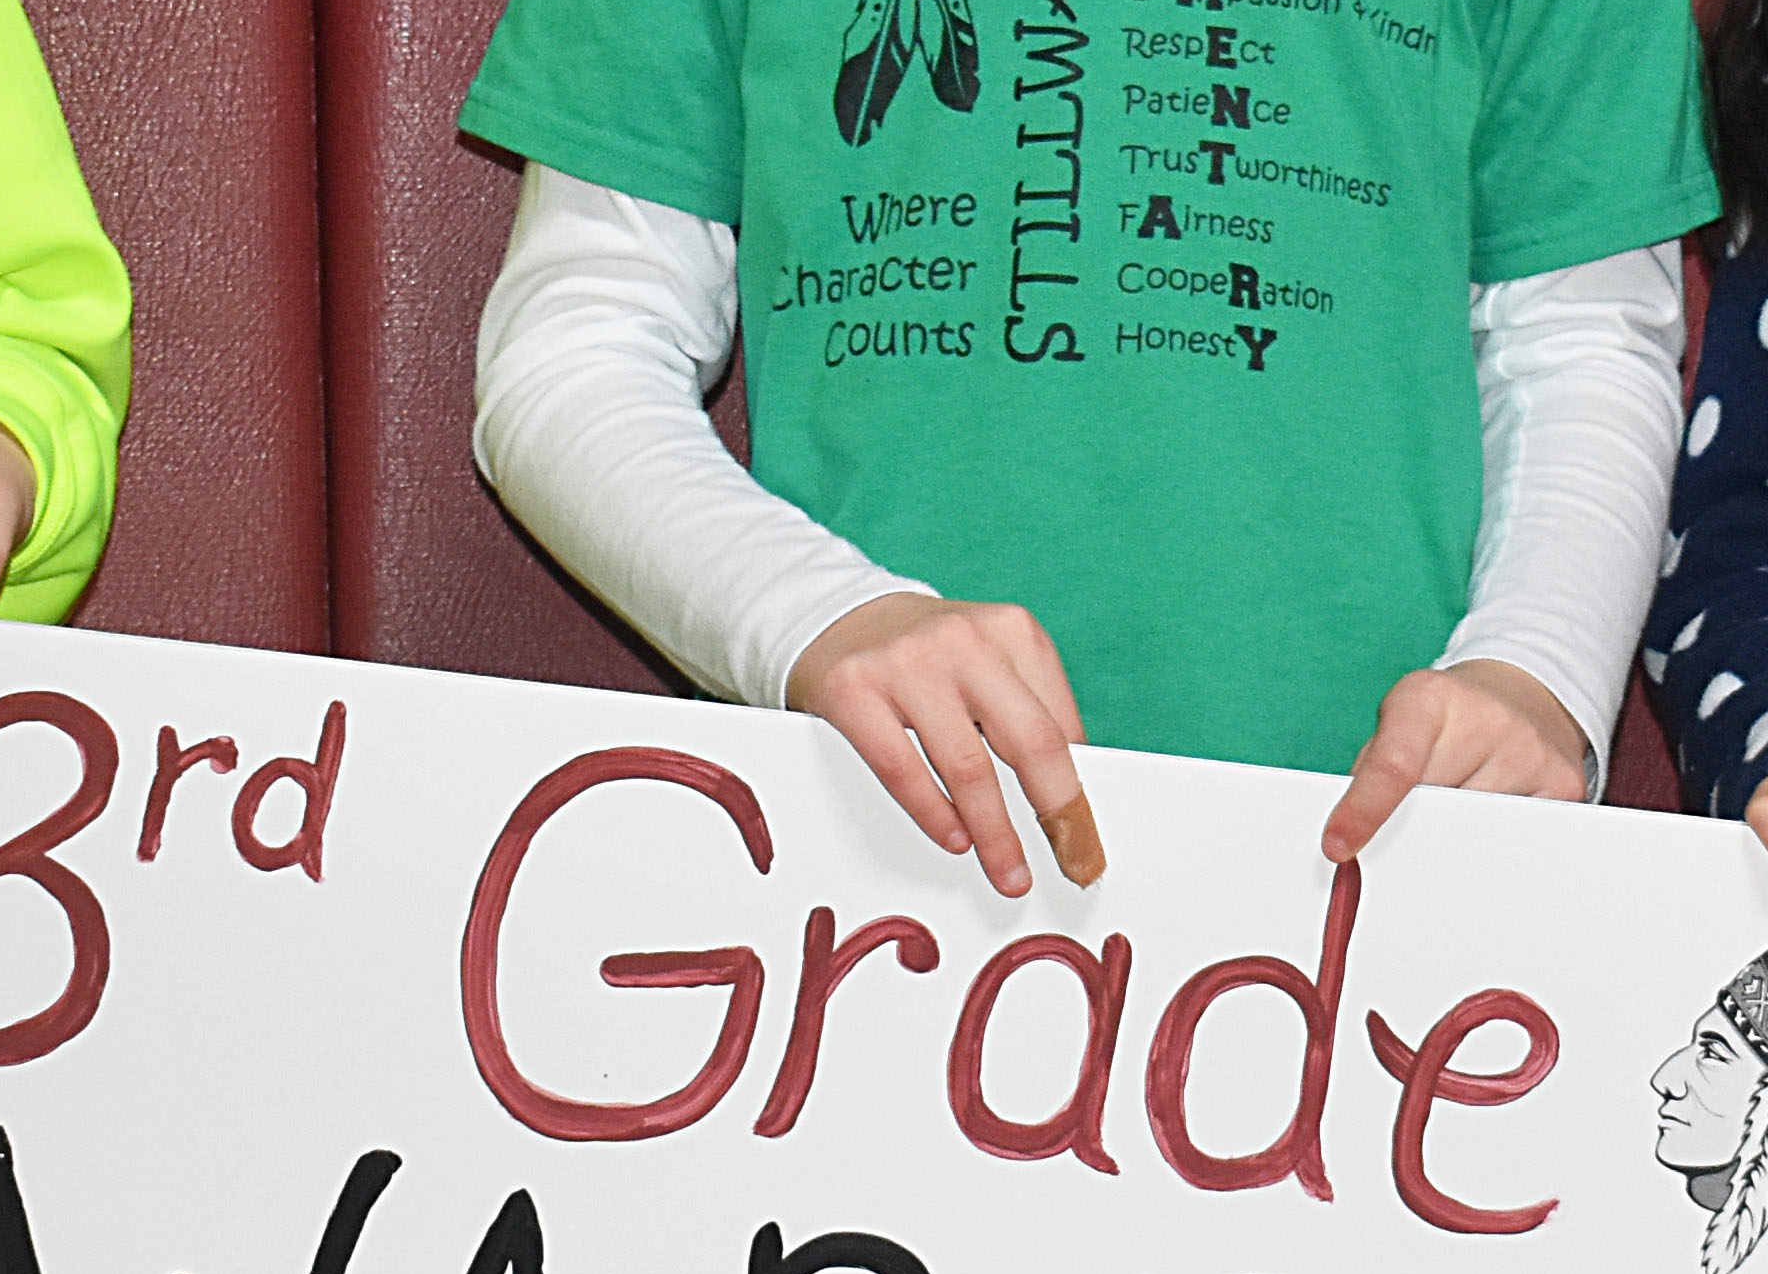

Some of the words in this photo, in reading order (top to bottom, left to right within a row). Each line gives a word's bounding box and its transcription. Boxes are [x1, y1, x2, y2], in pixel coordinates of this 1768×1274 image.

[1121, 25, 1276, 69] RespEct
[1122, 83, 1291, 129] PatieNce
[1119, 140, 1392, 207] TrusTworthiness
[840, 192, 977, 245] Where
[1118, 194, 1275, 243] FAirness
[1116, 261, 1333, 314] CoopeRation
[824, 320, 976, 367] Counts
[1116, 323, 1277, 372] HonestY
[460, 746, 1561, 1235] Grade
